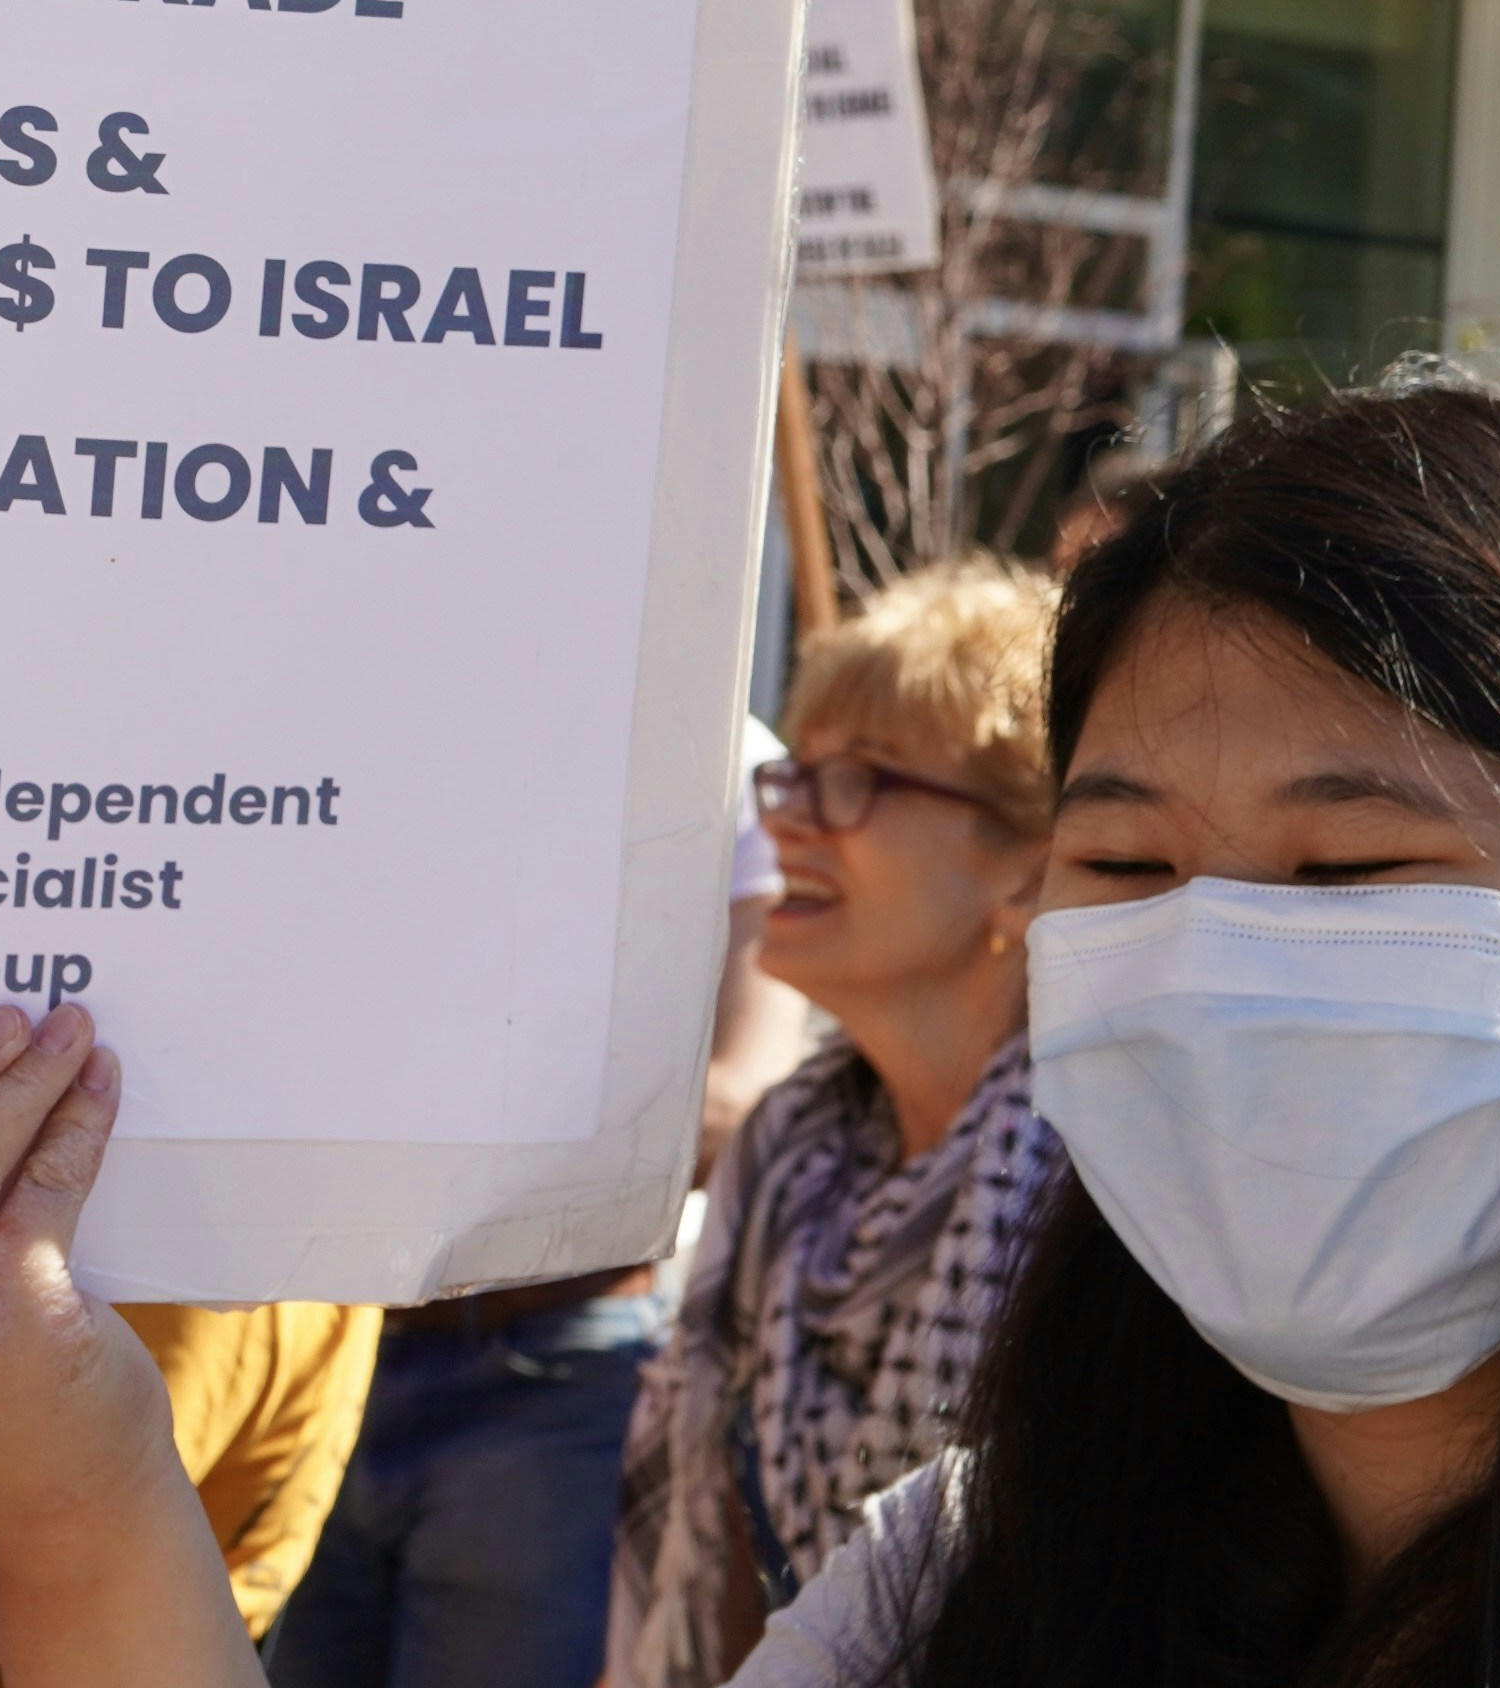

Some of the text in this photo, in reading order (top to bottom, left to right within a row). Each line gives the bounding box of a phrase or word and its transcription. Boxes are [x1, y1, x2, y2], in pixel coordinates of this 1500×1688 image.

[84, 110, 171, 196] &
[84, 246, 233, 336] TO
[257, 257, 605, 352] ISRAEL
[356, 448, 437, 530] &
